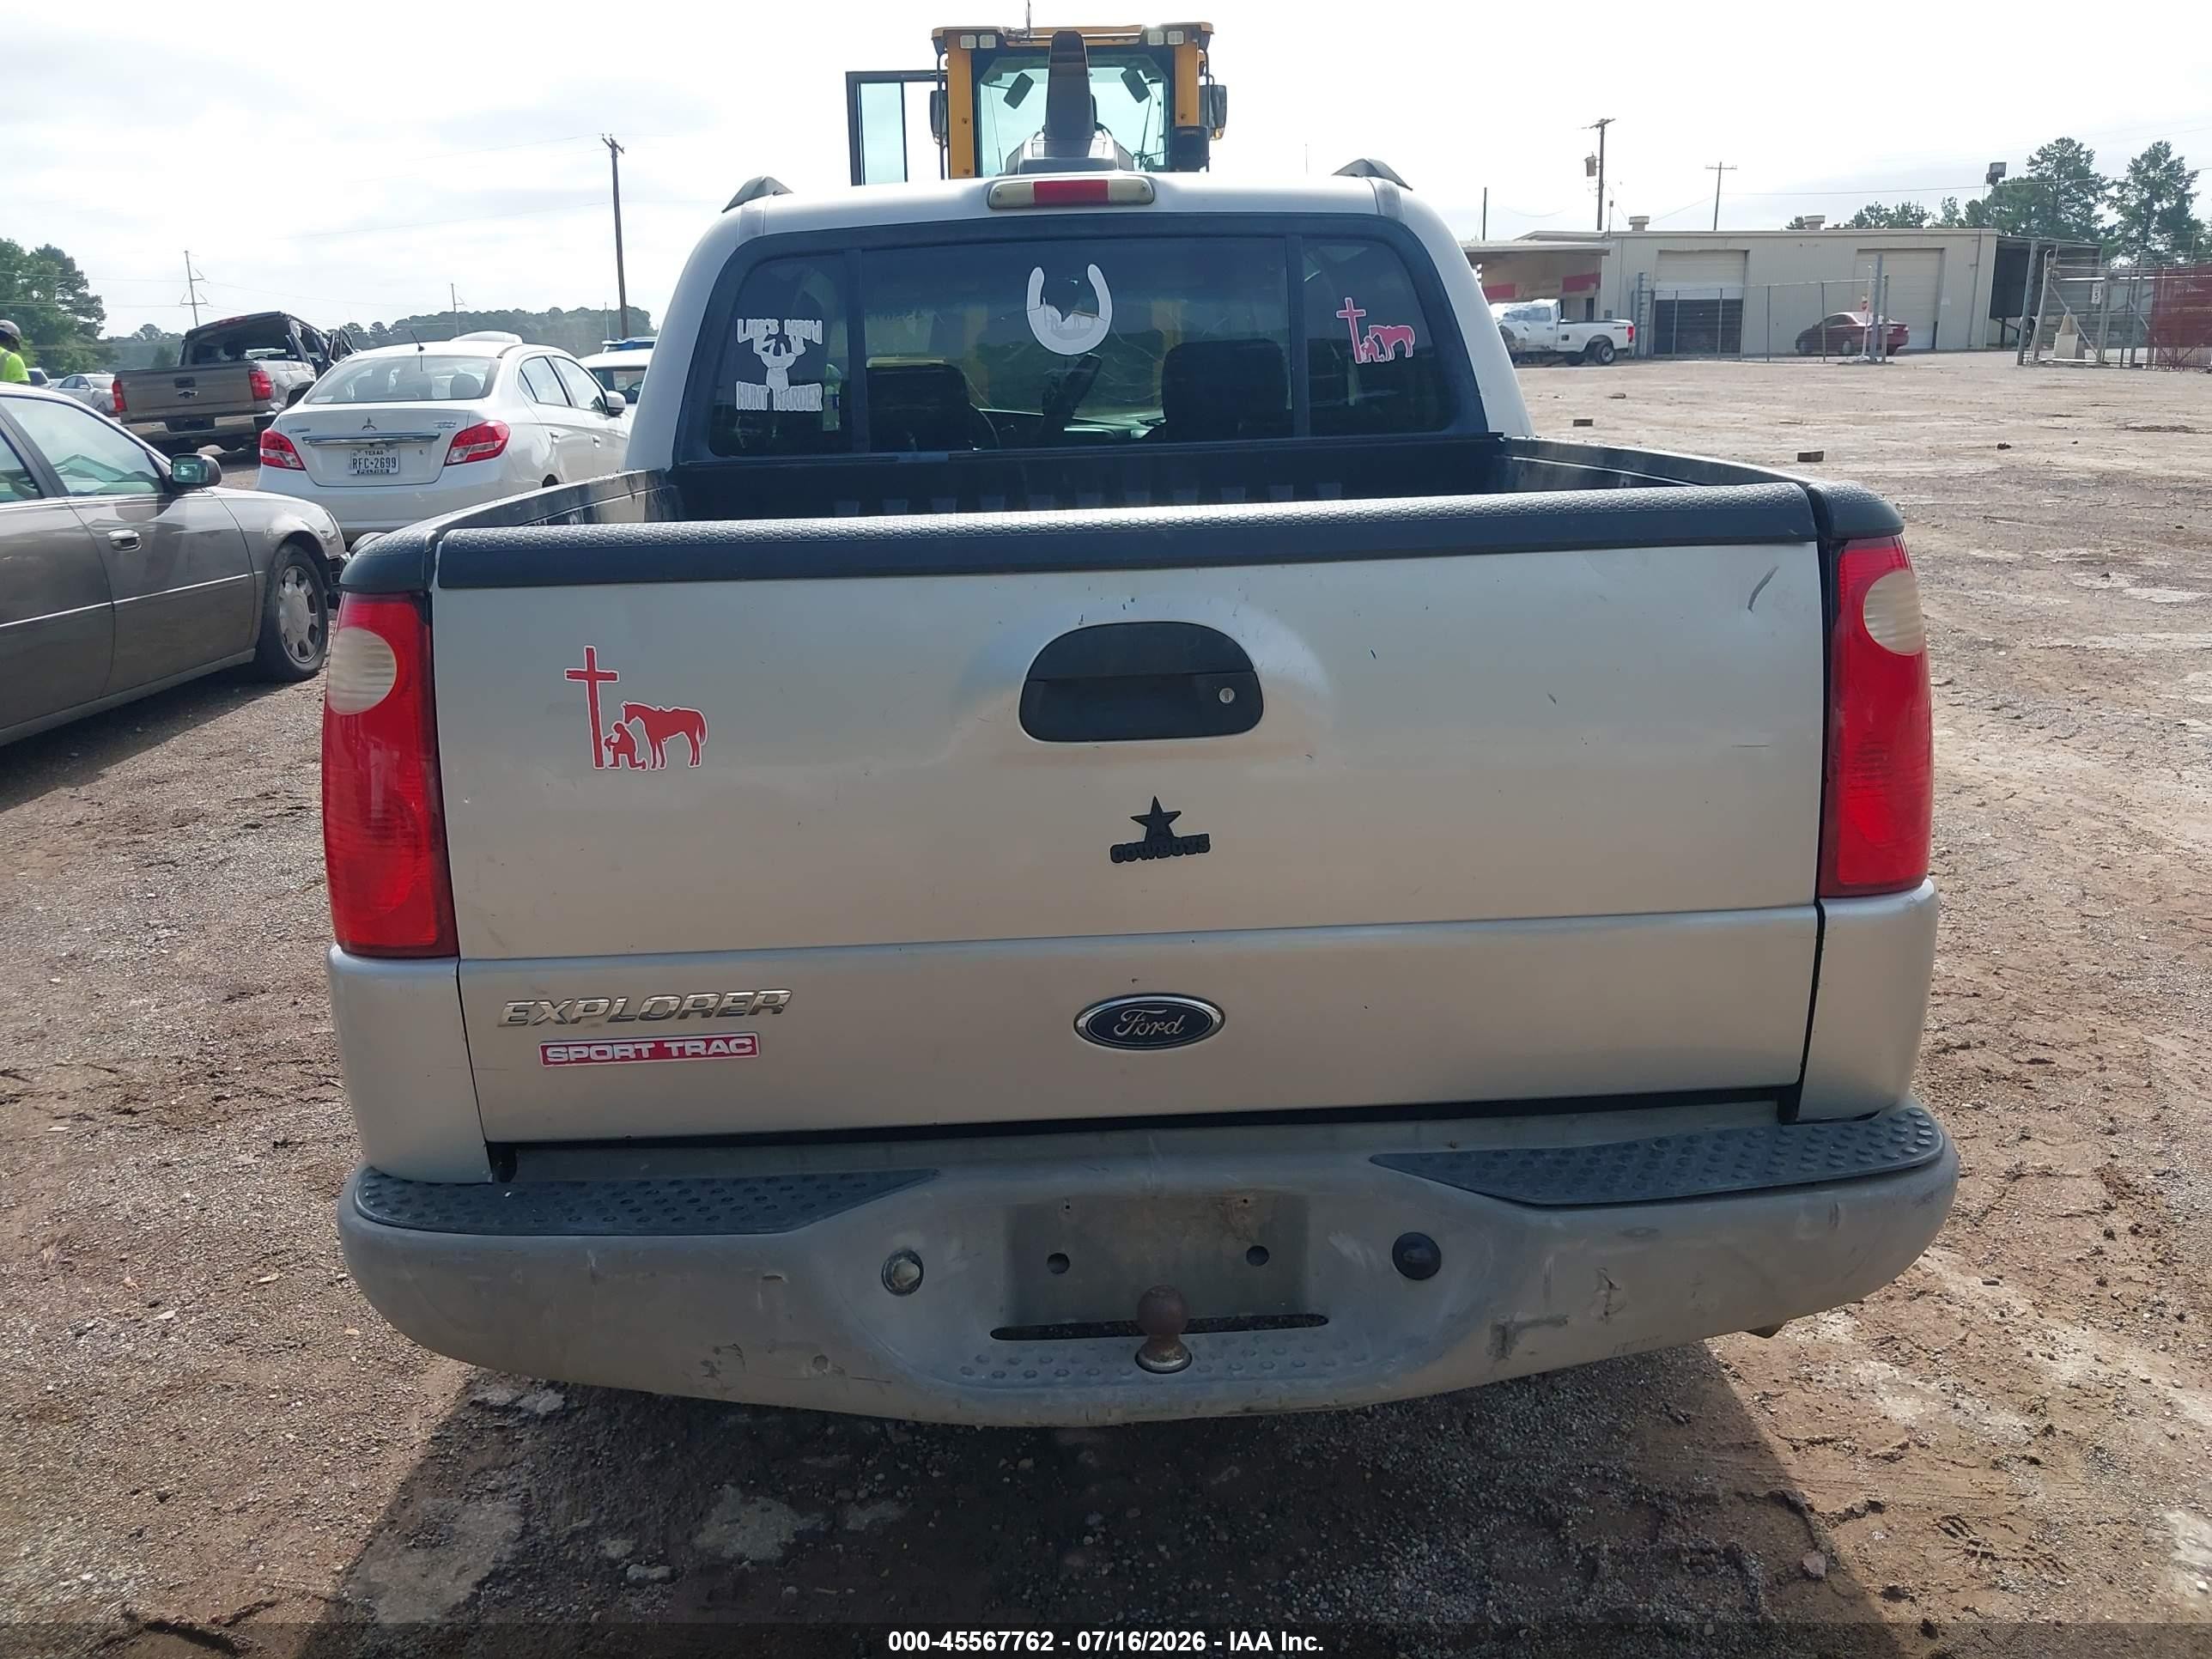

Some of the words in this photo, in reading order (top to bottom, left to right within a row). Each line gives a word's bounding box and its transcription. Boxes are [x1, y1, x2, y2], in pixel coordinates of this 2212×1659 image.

[736, 381, 769, 410] HUNT
[773, 383, 823, 411] HARDER
[1110, 834, 1211, 864] COWBOYS
[498, 988, 793, 1027] EXPLORER
[1113, 1009, 1185, 1036] Ford
[545, 1042, 656, 1063] SPORT
[664, 1037, 754, 1058] TRAC
